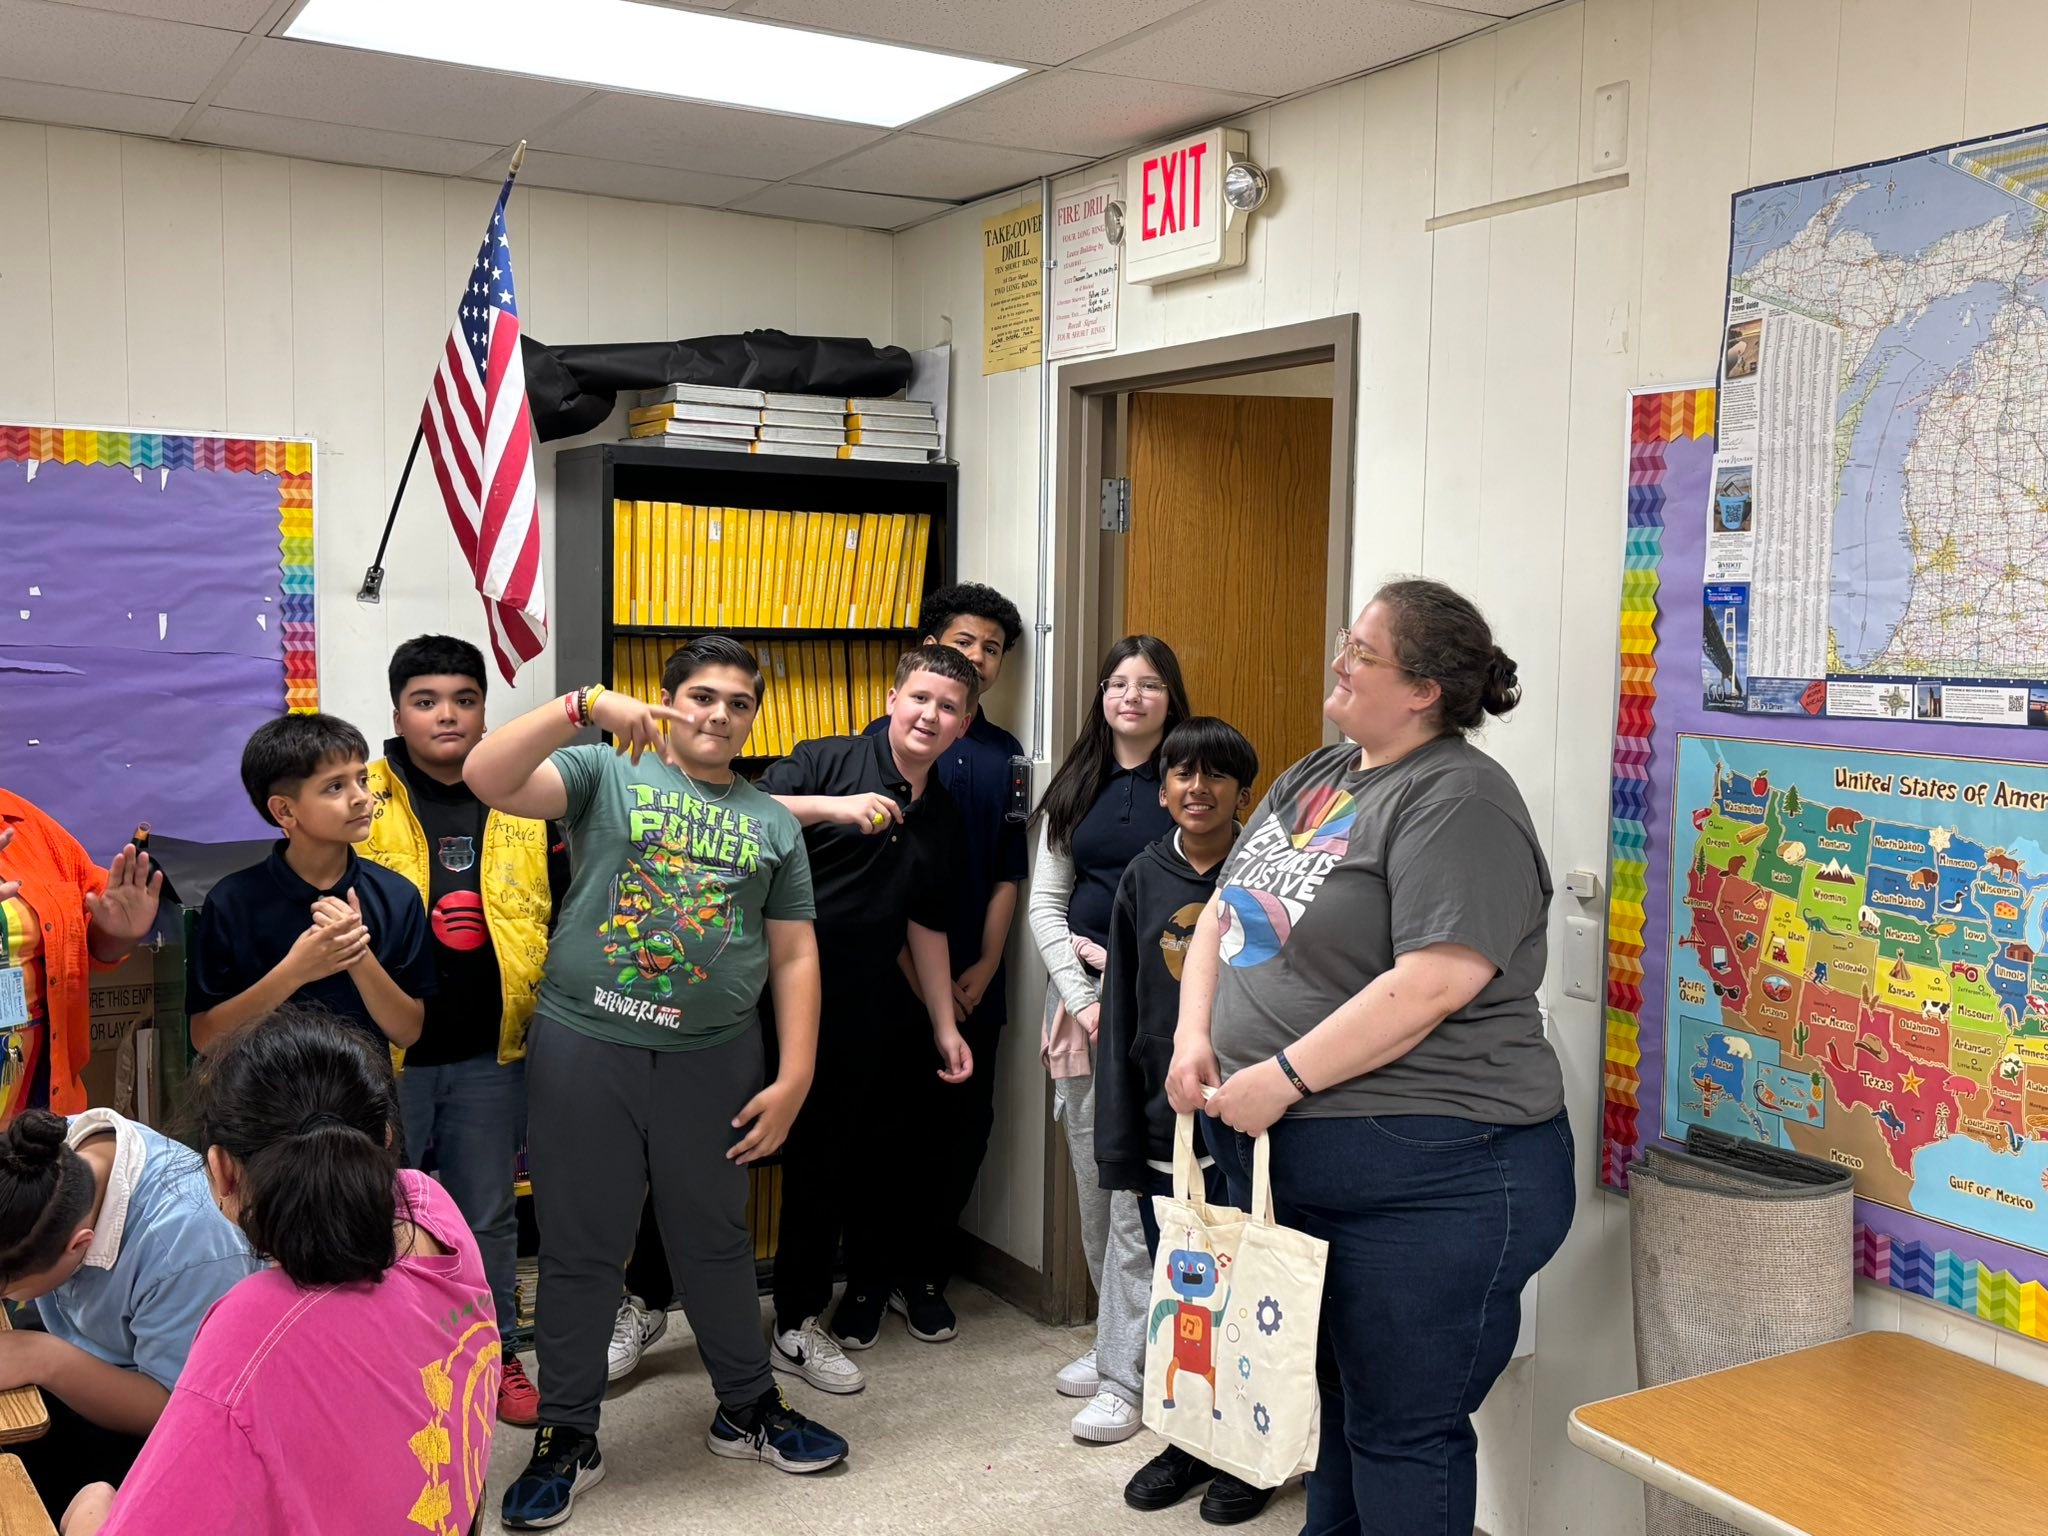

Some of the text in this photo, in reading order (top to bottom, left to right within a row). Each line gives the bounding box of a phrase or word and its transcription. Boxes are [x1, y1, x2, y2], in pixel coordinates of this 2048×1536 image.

[1142, 142, 1207, 241] EXIT
[1058, 203, 1080, 226] FIRE
[1002, 239, 1030, 262] DRILL
[1022, 257, 1038, 267] RINGS
[994, 279, 1038, 296] TWO LONG RINGS
[1836, 768, 1892, 793] United
[1900, 776, 1957, 800] States
[1964, 784, 1988, 805] of
[627, 784, 762, 839] TURTLE
[1725, 801, 1764, 814] Washington
[630, 809, 760, 873] POWER
[1706, 837, 1730, 848] Oregon
[1819, 838, 1851, 850] Montana
[1875, 837, 1925, 853] North Dakota
[1304, 852, 1342, 876] IS
[1940, 855, 1977, 870] Minnesota
[1772, 870, 1792, 883] Idaho
[1813, 889, 1847, 904] Wyoming
[1977, 882, 2019, 897] Wisconsin
[1683, 896, 1713, 909] California
[1872, 892, 1925, 908] South Dakota
[1733, 911, 1758, 923] Nevada
[1788, 931, 1805, 942] Utah
[1885, 929, 1921, 943] Nebraska
[1964, 927, 1985, 941] Iowa
[1833, 960, 1868, 975] Colorado
[1996, 965, 2025, 980] Illinois
[1678, 977, 1706, 993] Pacific
[1888, 983, 1916, 998] Kansas
[107, 989, 130, 1008] THIS
[593, 986, 658, 1022] DEFENDERS
[1680, 990, 1705, 1005] Ocean
[654, 1011, 682, 1029] NYC
[1761, 1005, 1788, 1019] Arizona
[1958, 1005, 1994, 1021] Missouri
[107, 1021, 126, 1038] LAY
[1811, 1014, 1856, 1031] New Mexico
[1900, 1020, 1940, 1036] Oklahoma
[1955, 1039, 1992, 1055] Arkansas
[1712, 1058, 1733, 1071] Alaska
[1860, 1072, 1894, 1091] Texas
[1780, 1097, 1802, 1109] Hawaii
[1963, 1116, 1999, 1132] Louisiana
[1831, 1150, 1862, 1168] Mexico
[1950, 1175, 2033, 1210] Gulf of Mexico
